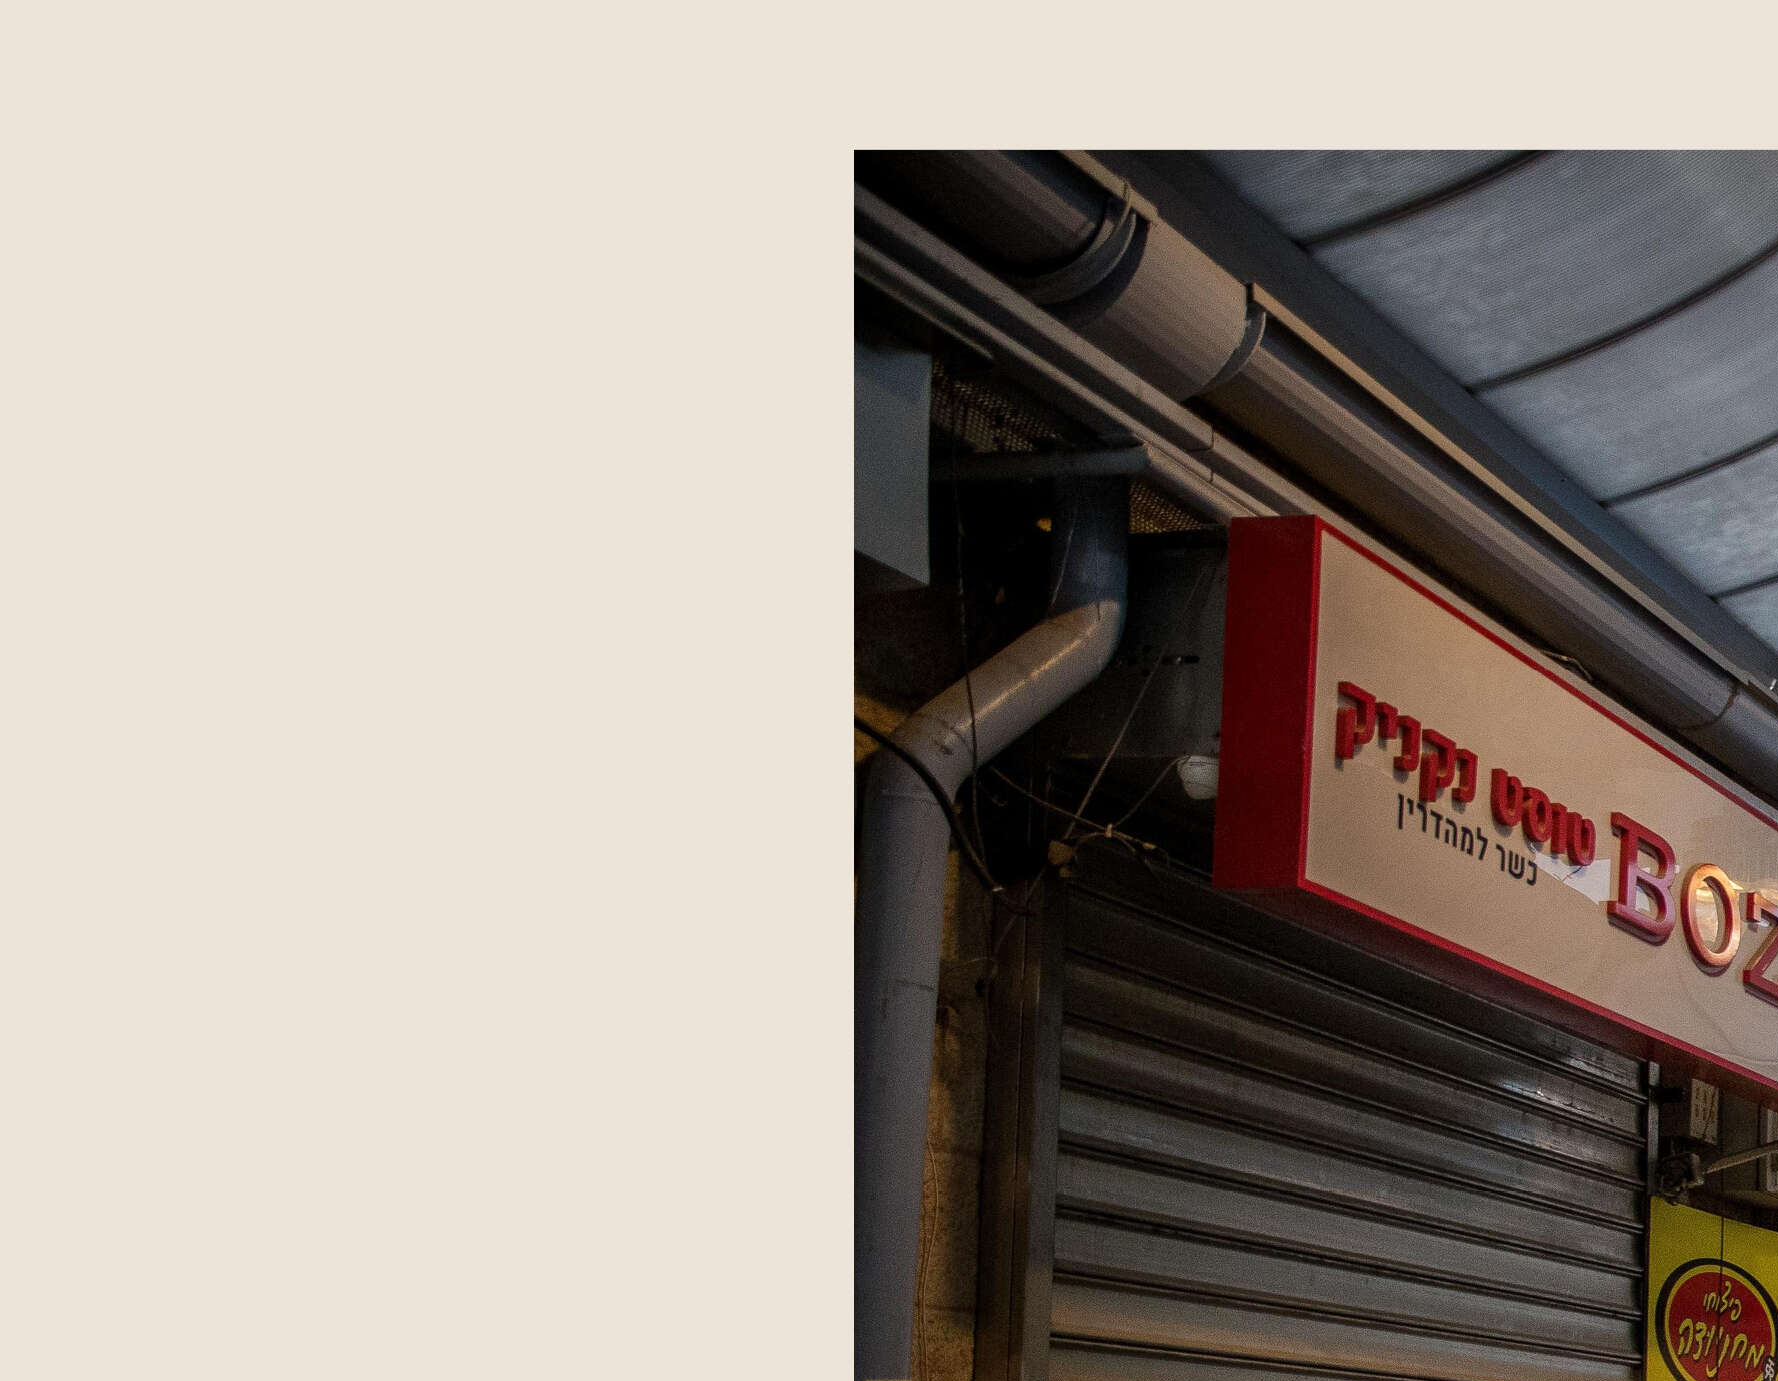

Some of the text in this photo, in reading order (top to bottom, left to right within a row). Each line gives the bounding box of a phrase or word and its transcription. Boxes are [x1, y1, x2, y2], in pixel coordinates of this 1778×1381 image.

[1335, 680, 1596, 868] טוסט נקניק
[1397, 793, 1538, 886] כשר למהדרין
